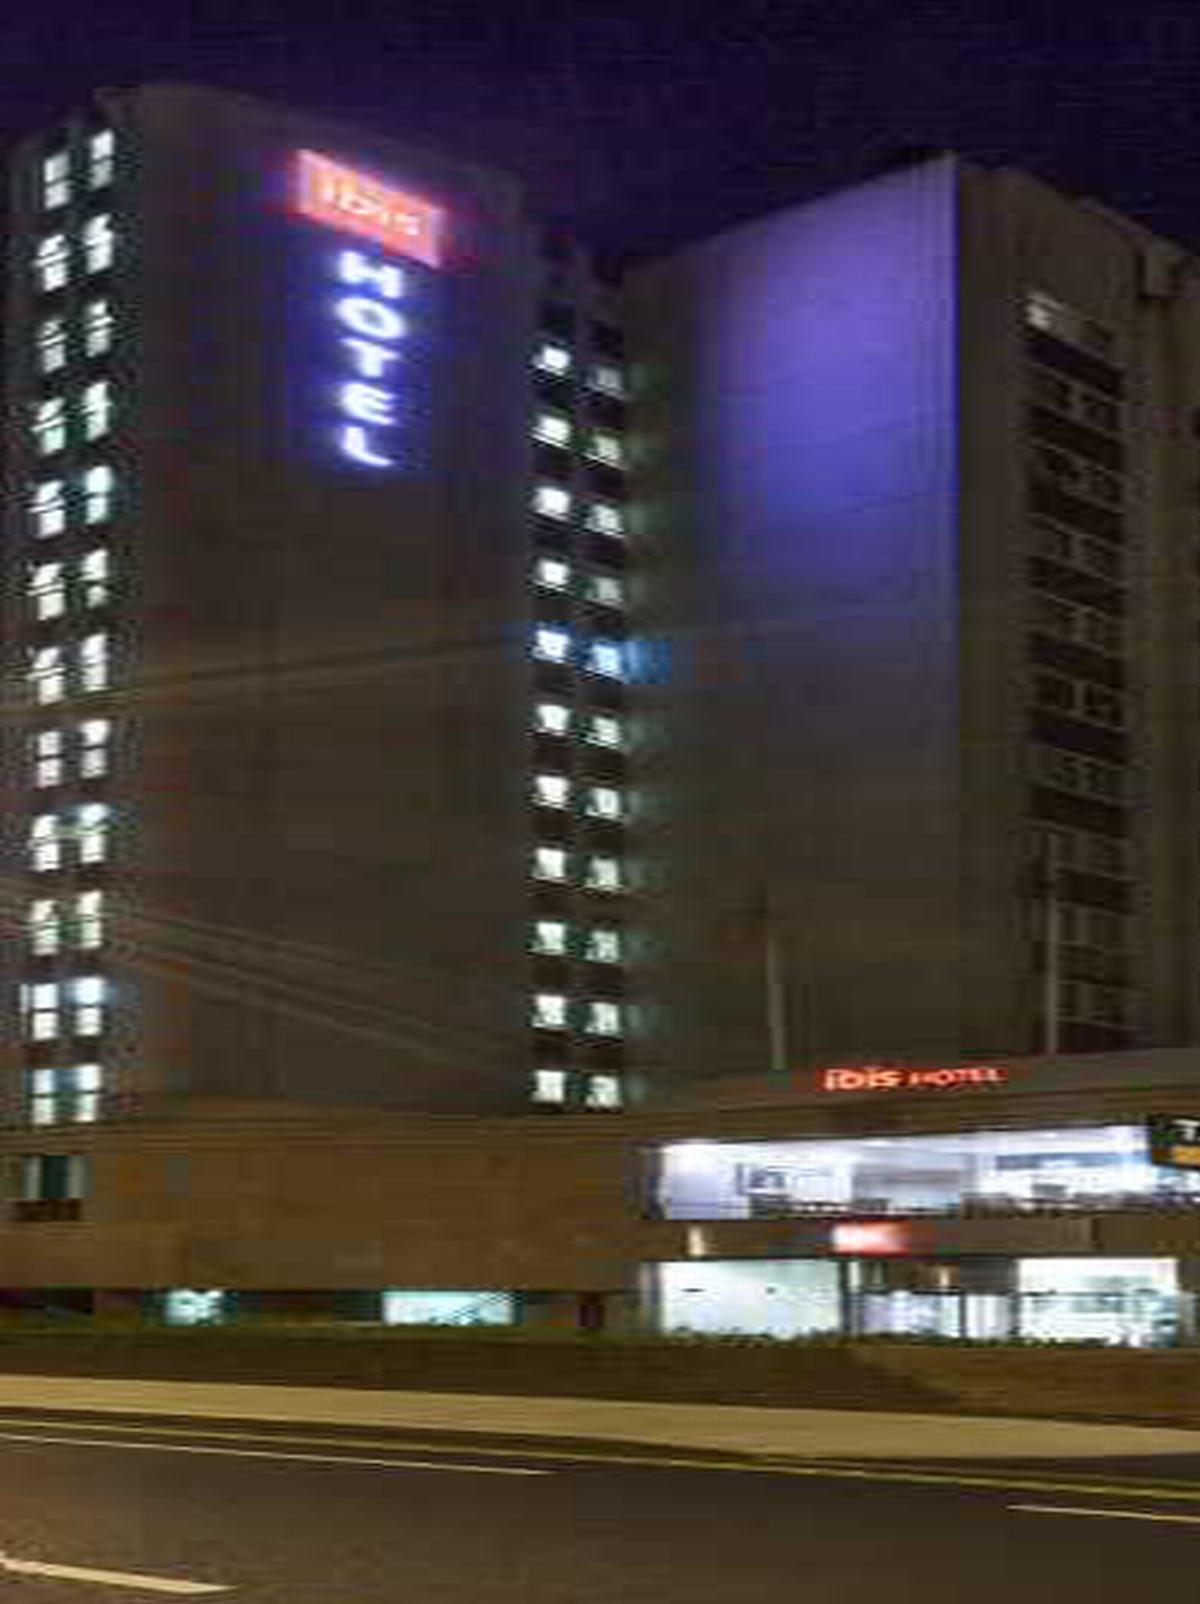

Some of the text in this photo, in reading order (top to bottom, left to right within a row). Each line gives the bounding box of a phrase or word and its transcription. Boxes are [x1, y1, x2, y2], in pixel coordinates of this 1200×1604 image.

[335, 250, 406, 467] HOTEL
[823, 1066, 1003, 1092] ibis HOTEL
